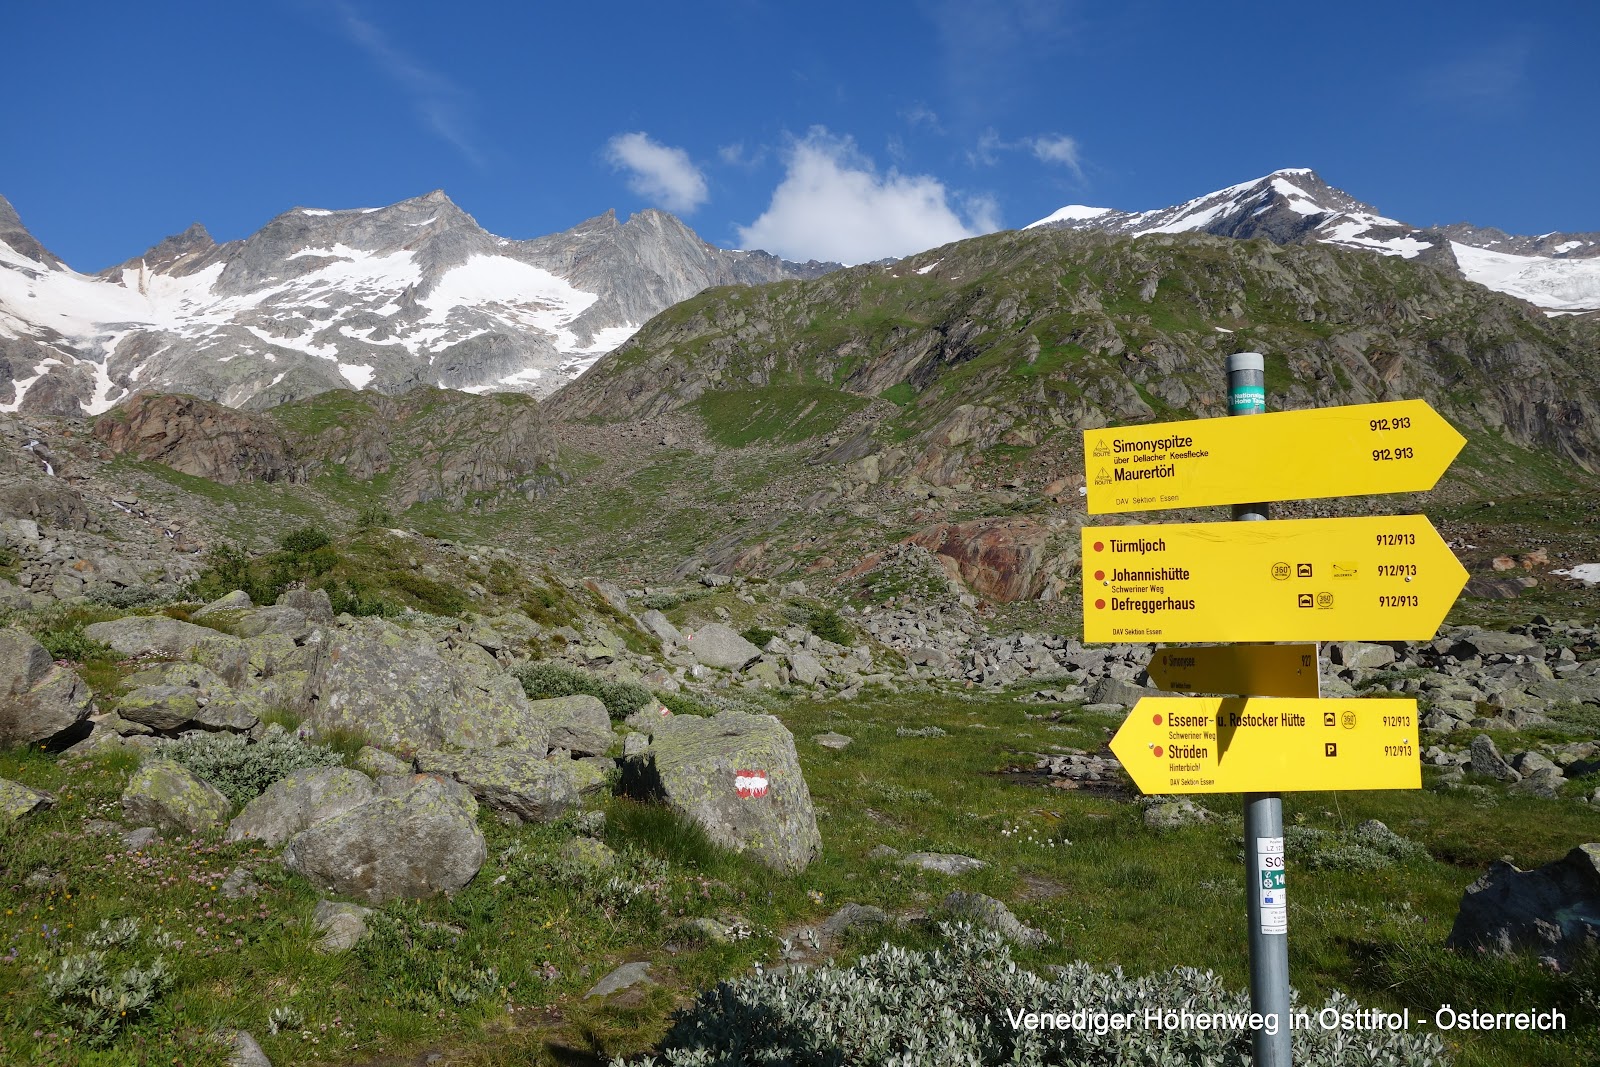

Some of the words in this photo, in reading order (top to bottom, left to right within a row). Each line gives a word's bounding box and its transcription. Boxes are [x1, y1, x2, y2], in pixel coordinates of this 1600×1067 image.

[1113, 435, 1193, 454] Simonyspitze
[1113, 456, 1130, 465] über
[1133, 454, 1166, 463] Dellacher
[1170, 450, 1209, 460] Keesflecke
[1114, 463, 1175, 482] Maurertörl
[1115, 498, 1129, 506] DAV
[1132, 496, 1157, 504] Sektion
[1160, 494, 1180, 503] Essen
[1376, 533, 1416, 546] 912/913
[1110, 538, 1166, 555] Türmljoch
[1111, 567, 1190, 582] Johannishütte
[1274, 566, 1288, 574] 360
[1377, 564, 1417, 577] 912/913
[1111, 585, 1149, 594] Schweriner
[1150, 585, 1164, 594] Weg
[1111, 597, 1196, 614] Defreggerhaus
[1379, 595, 1419, 608] 912/913
[1112, 628, 1123, 636] DAV
[1124, 628, 1145, 636] Sektion
[1146, 628, 1162, 636] Essen
[1168, 713, 1215, 727] Essener-
[1217, 715, 1227, 727] u.
[1229, 713, 1279, 727] Rostocker
[1281, 713, 1306, 727] Hütte
[1382, 716, 1411, 727] 912/913
[1168, 731, 1202, 740] Schweriner
[1203, 731, 1216, 741] Weg
[1168, 744, 1208, 759] Ströden
[1384, 746, 1412, 757] 912/913
[1169, 763, 1201, 772] Hinterbichl
[1181, 778, 1199, 786] Sektion
[1274, 874, 1286, 886] 14
